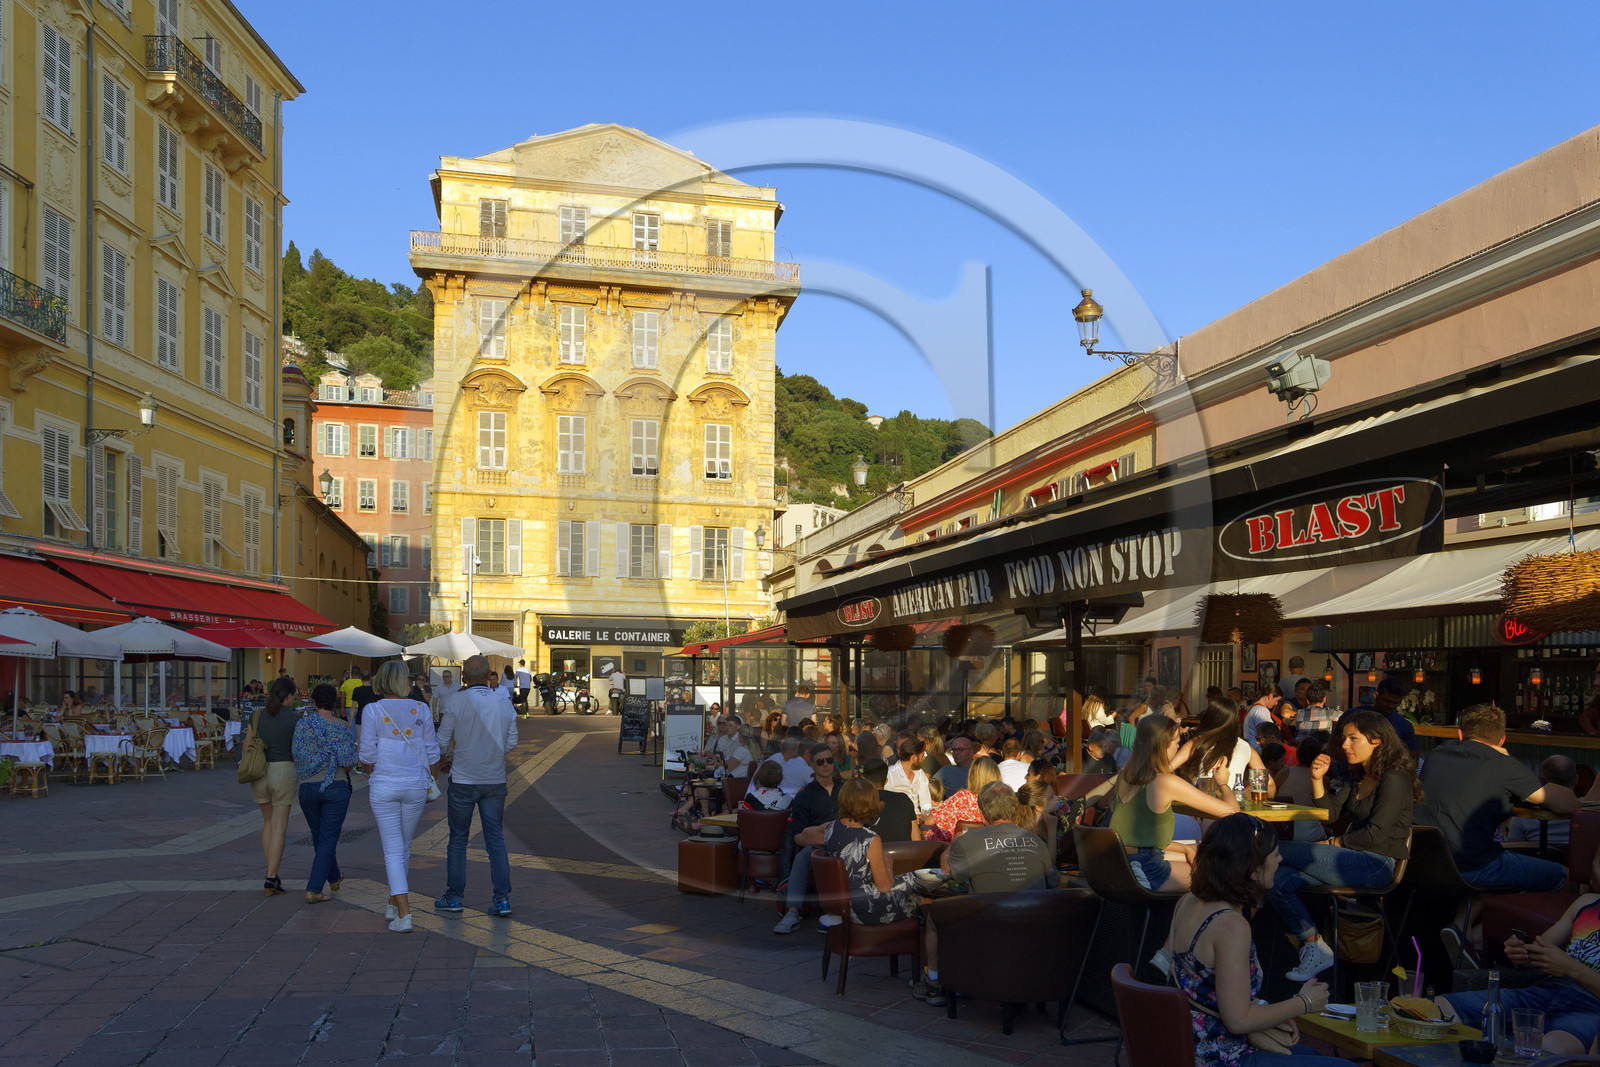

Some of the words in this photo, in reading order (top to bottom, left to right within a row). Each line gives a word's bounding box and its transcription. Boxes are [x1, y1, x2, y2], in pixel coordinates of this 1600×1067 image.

[1246, 485, 1406, 555] BLAST
[893, 576, 955, 618] AMERICAN
[958, 569, 993, 606] BAR
[1003, 555, 1057, 599] FOOD
[1060, 543, 1104, 591] NON
[1110, 526, 1182, 583] STOP
[169, 611, 220, 624] BRASSERIE
[842, 599, 875, 622] BLAST
[272, 622, 315, 632] RESTAURANT
[547, 629, 591, 642] GALERIE
[596, 629, 609, 642] LE
[614, 630, 671, 643] CONTAINER
[984, 836, 1038, 851] EAGLES
